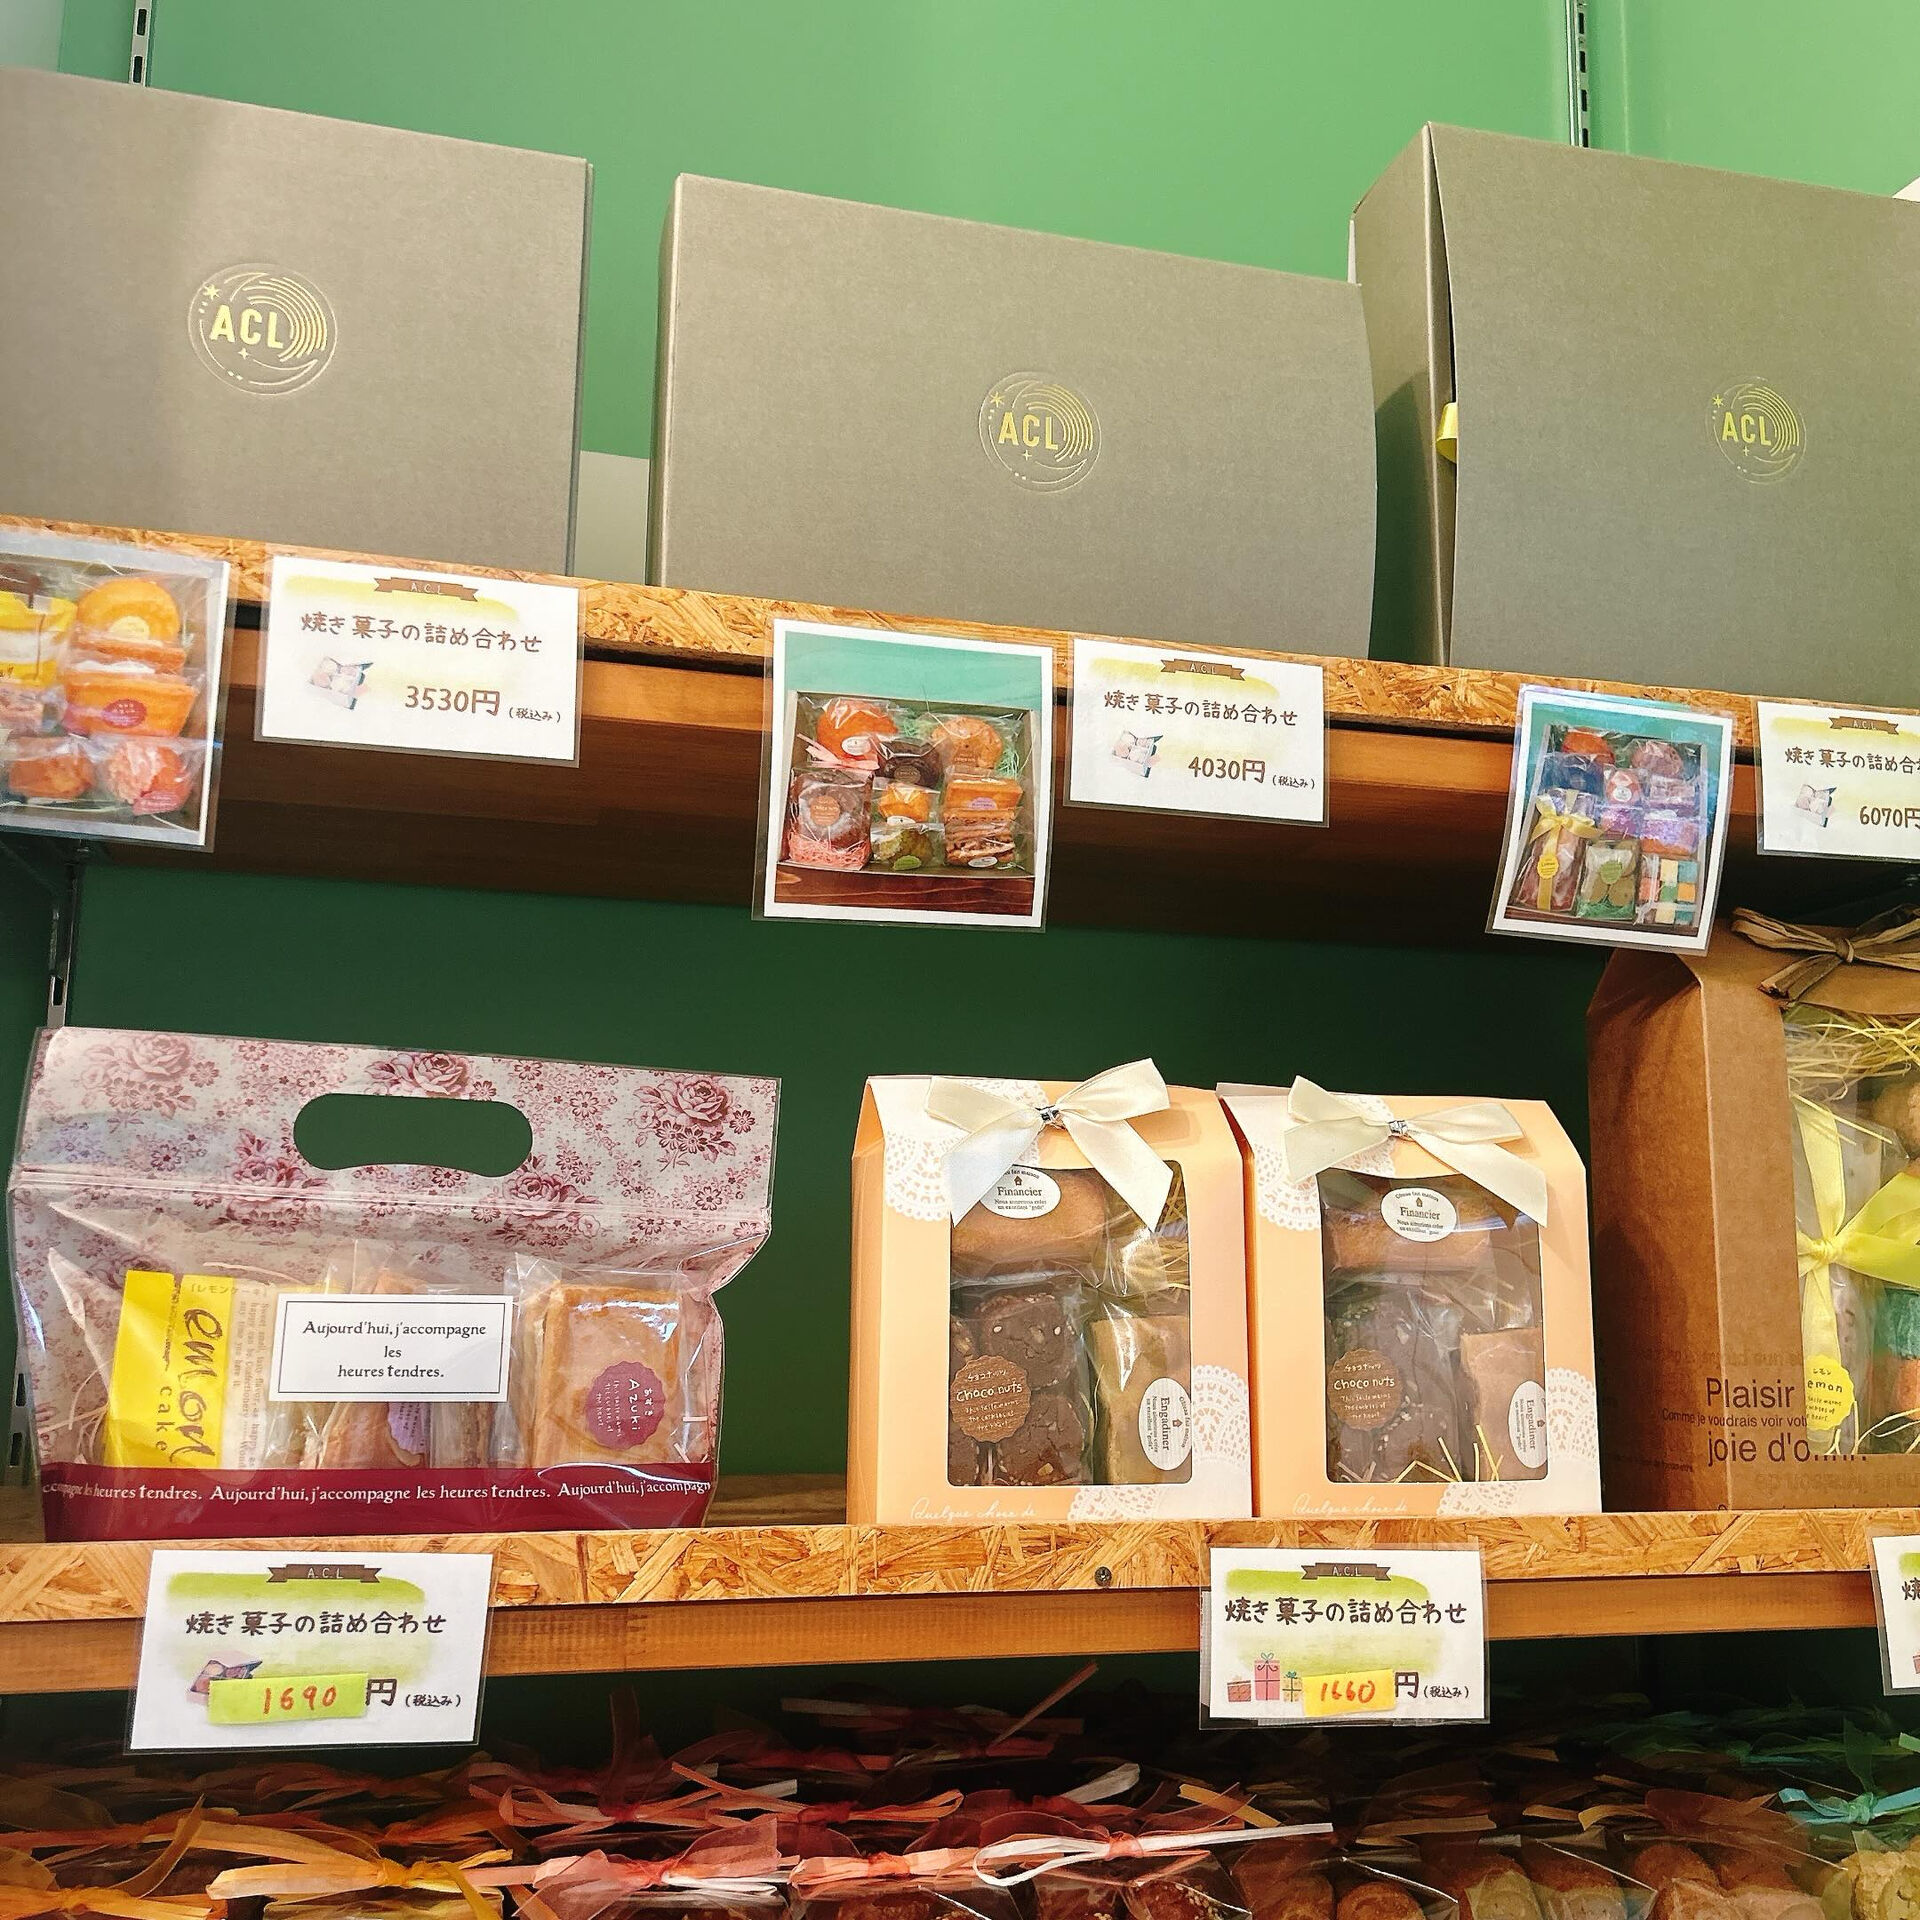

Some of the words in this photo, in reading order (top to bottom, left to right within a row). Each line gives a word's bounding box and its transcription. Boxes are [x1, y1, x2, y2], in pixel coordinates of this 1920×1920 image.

[209, 304, 284, 349] ACL
[998, 411, 1059, 451] ACL
[1722, 411, 1772, 446] ACL
[301, 611, 543, 653] 焼き菓子の詰め合わせ
[404, 685, 501, 717] 3530円
[1104, 689, 1299, 727] 焼き菓子の詰め合わせ
[1188, 756, 1267, 784] 4030円
[997, 1186, 1042, 1196] Financier
[1399, 1206, 1441, 1220] Financier
[384, 1345, 402, 1358] les
[169, 1308, 223, 1464] emon
[337, 1364, 384, 1378] heures
[387, 1364, 445, 1378] tendres.
[1807, 1380, 1843, 1393] emon
[628, 1378, 641, 1431] Azuki
[1706, 1377, 1795, 1408] Plaisir
[155, 1386, 175, 1451] cake
[1662, 1407, 1695, 1424] Comme
[1697, 1410, 1706, 1426] je
[1708, 1412, 1758, 1427] voudrais
[1761, 1413, 1783, 1427] voir
[1707, 1430, 1757, 1467] joie
[139, 1484, 203, 1499] tendres.
[416, 1484, 436, 1499] les
[440, 1484, 488, 1499] heures
[491, 1482, 551, 1499] tendres.
[185, 1610, 448, 1637] 焼き菓子の詰め合わせ
[1224, 1596, 1468, 1626] 焼き菓子の詰め合わせ
[262, 1683, 338, 1715] 1690
[1320, 1679, 1377, 1704] 1660
